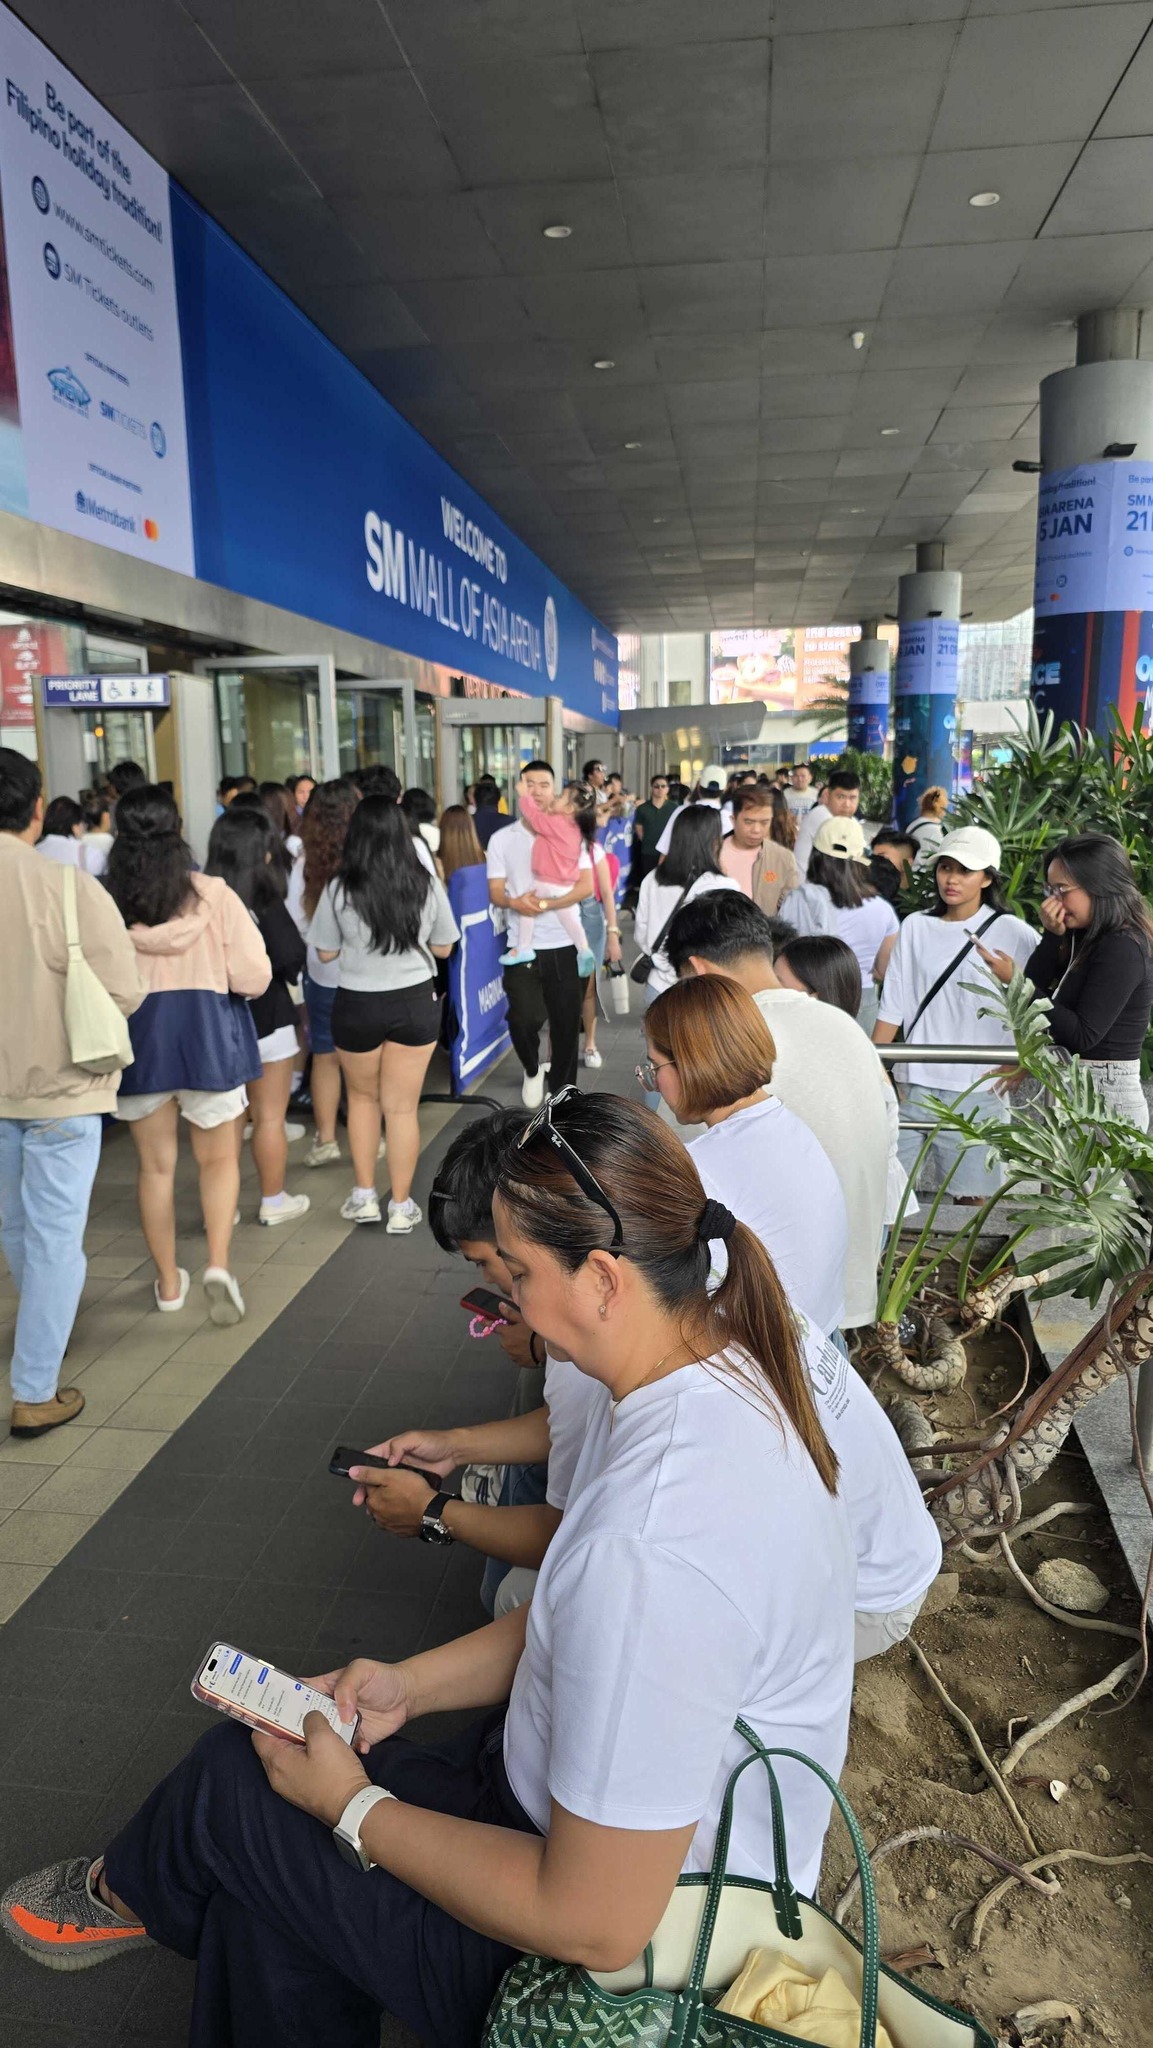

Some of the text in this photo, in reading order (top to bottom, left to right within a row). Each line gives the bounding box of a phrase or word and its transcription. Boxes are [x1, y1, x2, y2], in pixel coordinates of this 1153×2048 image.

[45, 81, 132, 185] Be part of the
[5, 78, 163, 244] Filipino holiday tradition!
[53, 202, 155, 294] www.smtickets.com
[64, 262, 154, 342] SM Tickets outlets
[86, 498, 136, 534] Metrobank
[1051, 497, 1094, 514] ARENA
[1128, 494, 1146, 506] SM
[1049, 513, 1092, 539] JAN
[1126, 510, 1147, 531] 21
[440, 496, 508, 585] WELCOME TO
[364, 509, 407, 605] SM
[408, 538, 460, 632] MALL
[459, 576, 481, 640] OF
[482, 591, 509, 656] ASIA
[509, 611, 542, 673] ARENA
[48, 679, 98, 691] PRIORITY
[69, 690, 99, 702] LANE
